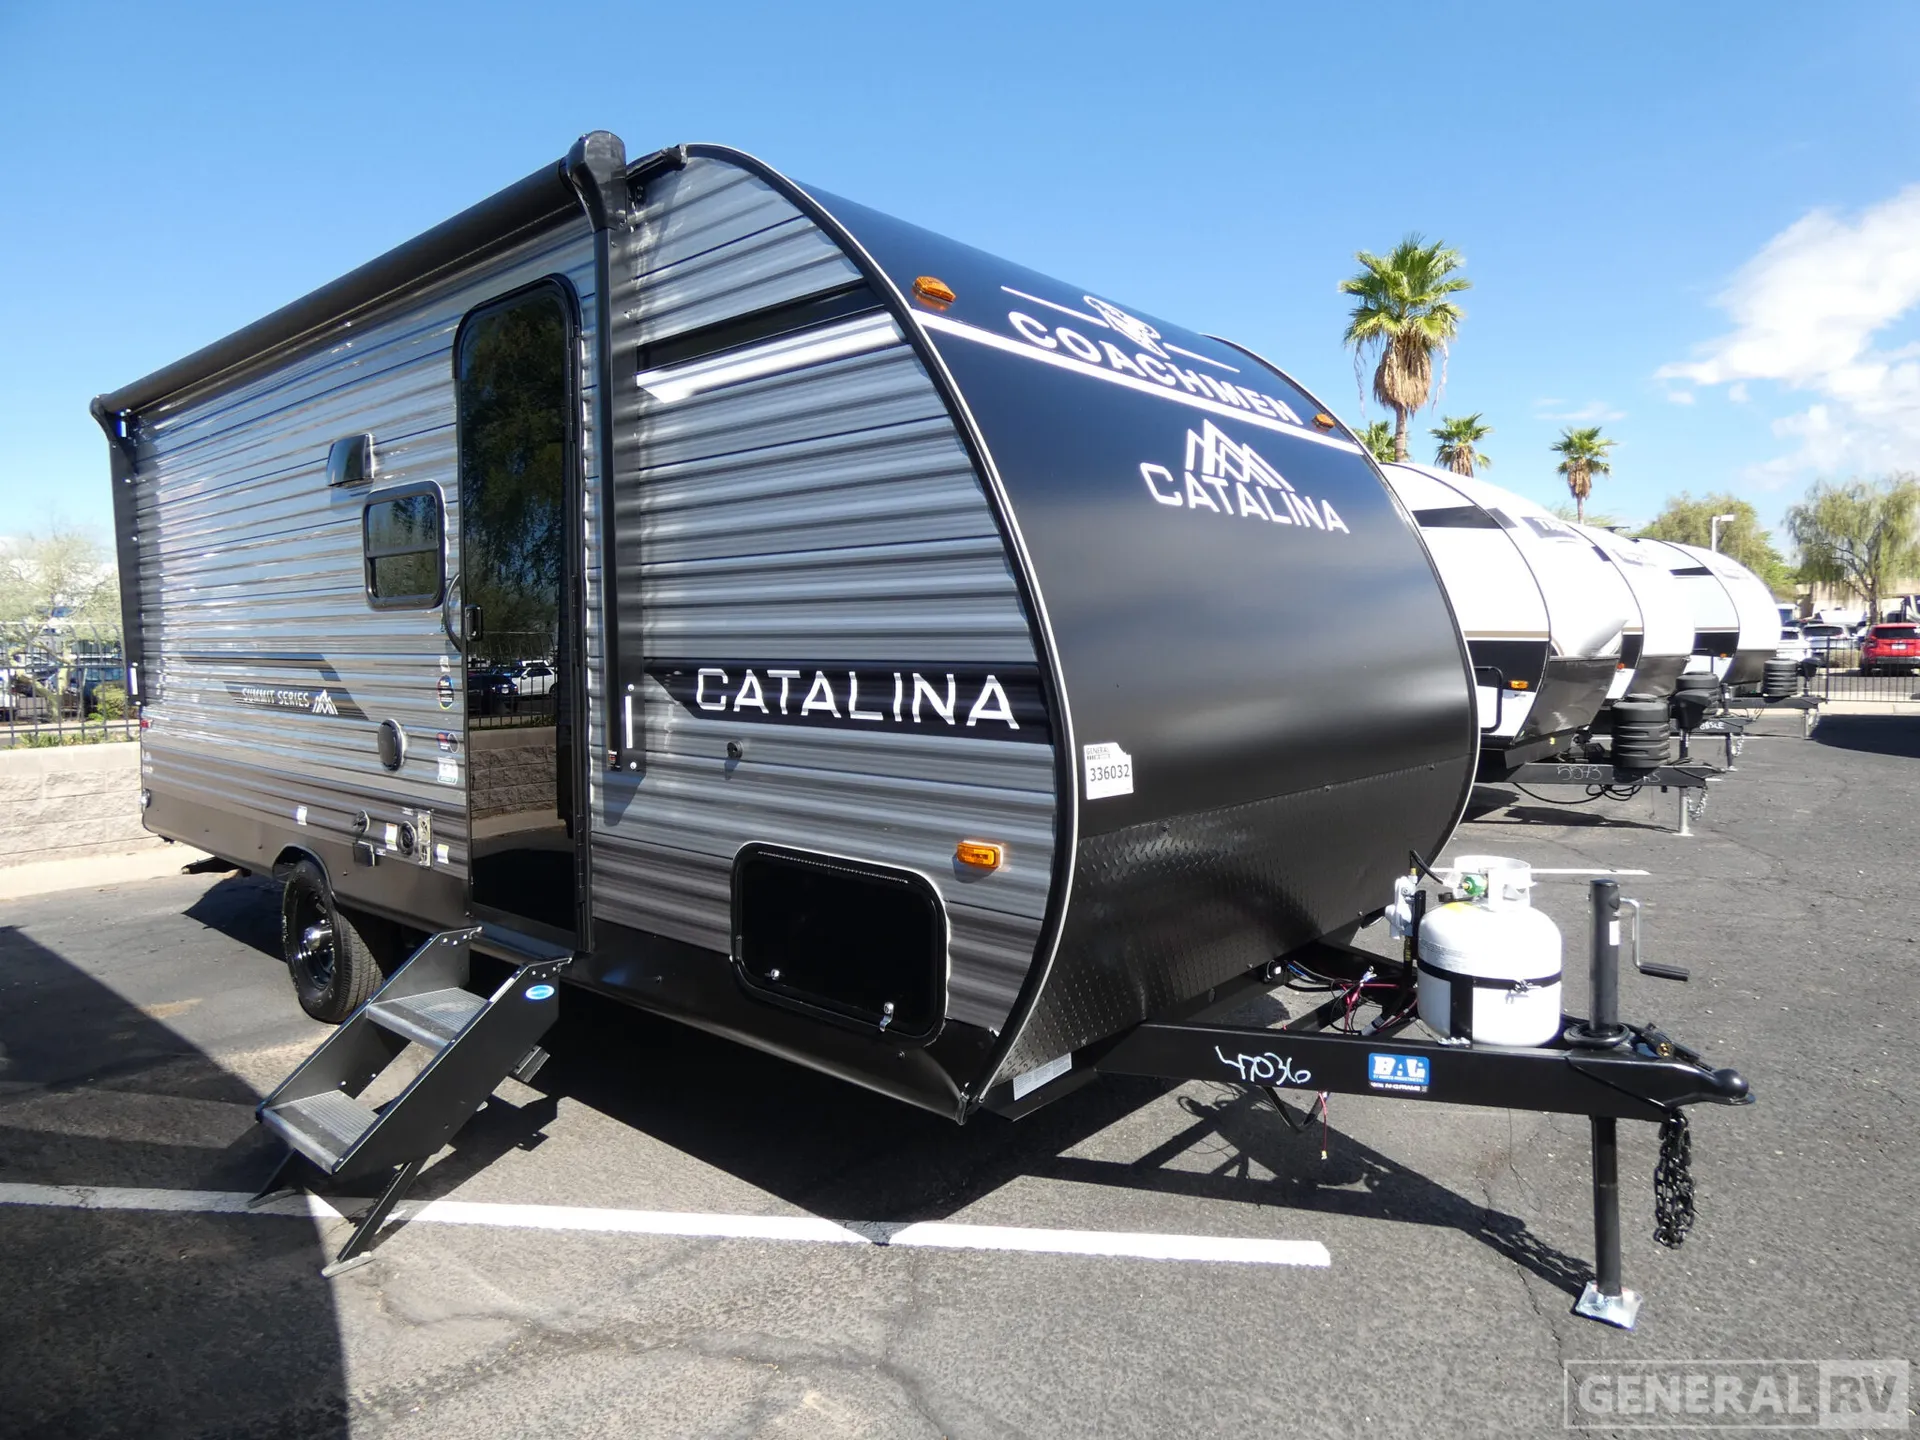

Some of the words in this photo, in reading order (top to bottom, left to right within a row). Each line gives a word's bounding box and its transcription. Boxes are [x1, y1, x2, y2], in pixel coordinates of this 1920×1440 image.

[1008, 311, 1303, 426] COACHMEN
[1140, 462, 1350, 534] CATALINA
[242, 687, 275, 704] SUMMIT
[277, 690, 310, 708] SERIES
[696, 668, 1021, 730] CATALINA
[1090, 764, 1130, 782] 336032
